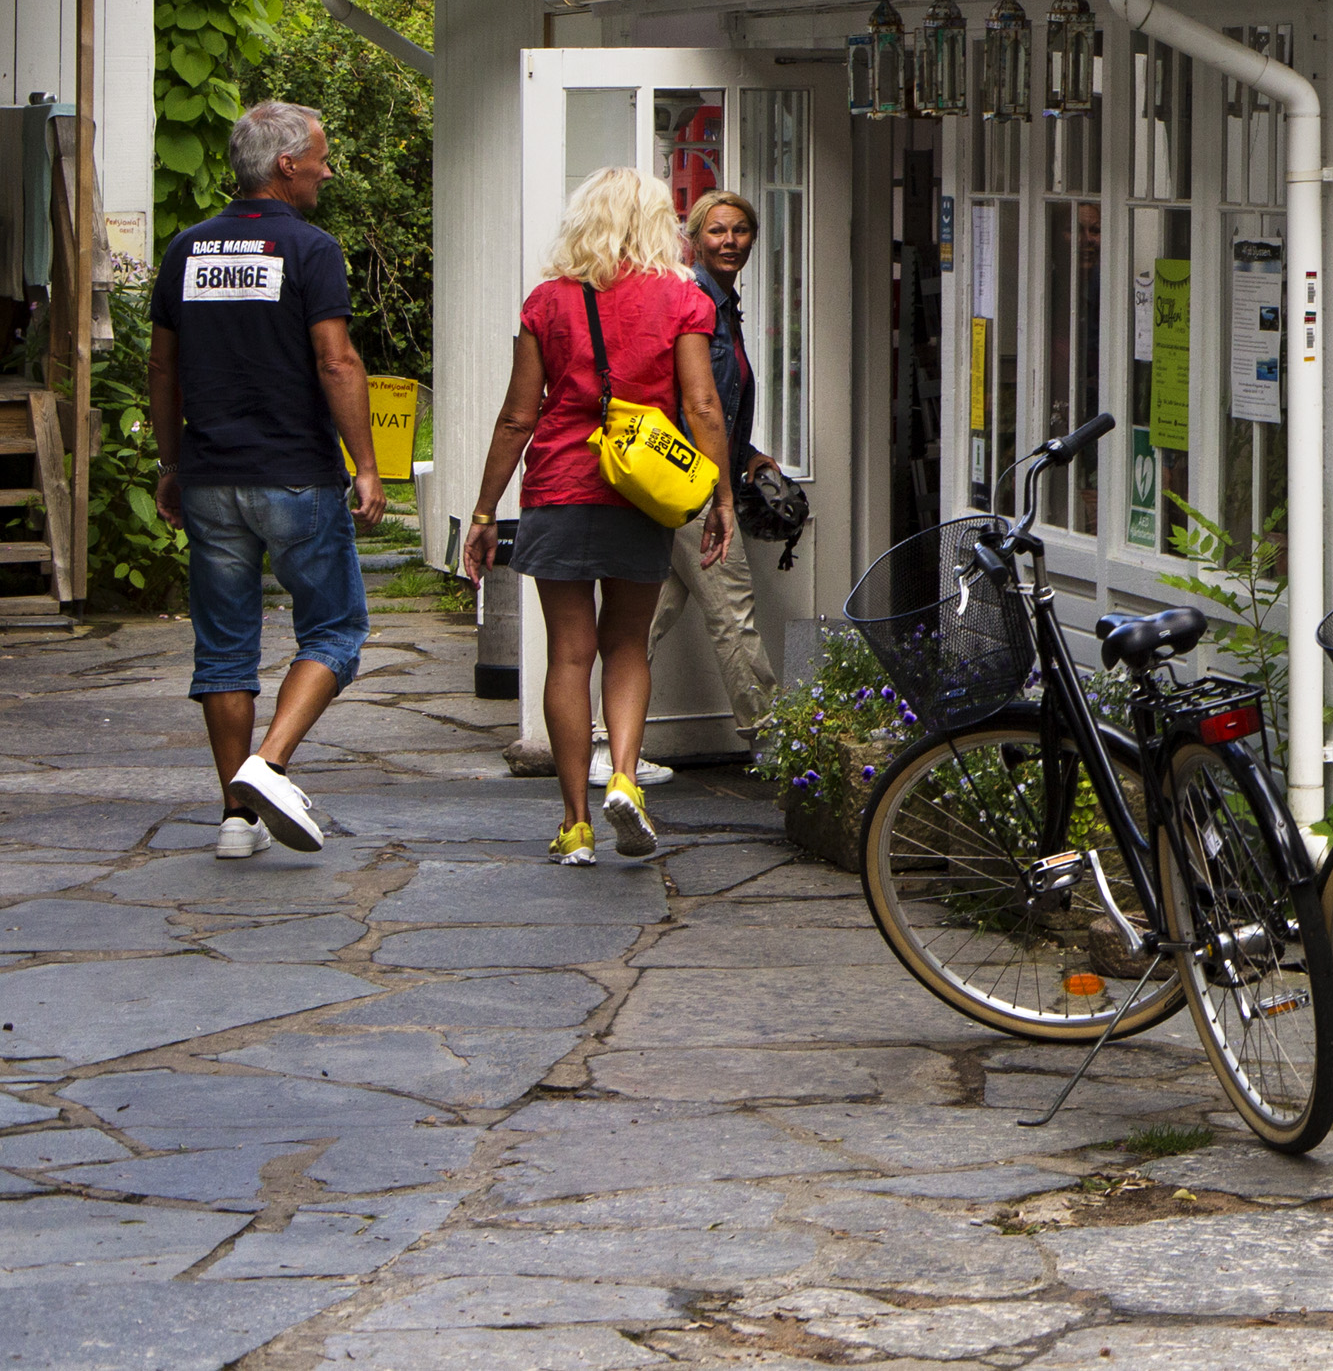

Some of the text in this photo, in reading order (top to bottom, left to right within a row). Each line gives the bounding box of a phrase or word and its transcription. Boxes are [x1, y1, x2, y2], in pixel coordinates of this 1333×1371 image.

[192, 240, 222, 254] RACE
[223, 240, 266, 253] MARINE
[195, 265, 269, 289] 58N16E
[371, 412, 412, 429] IVAT
[653, 431, 673, 456] Pack
